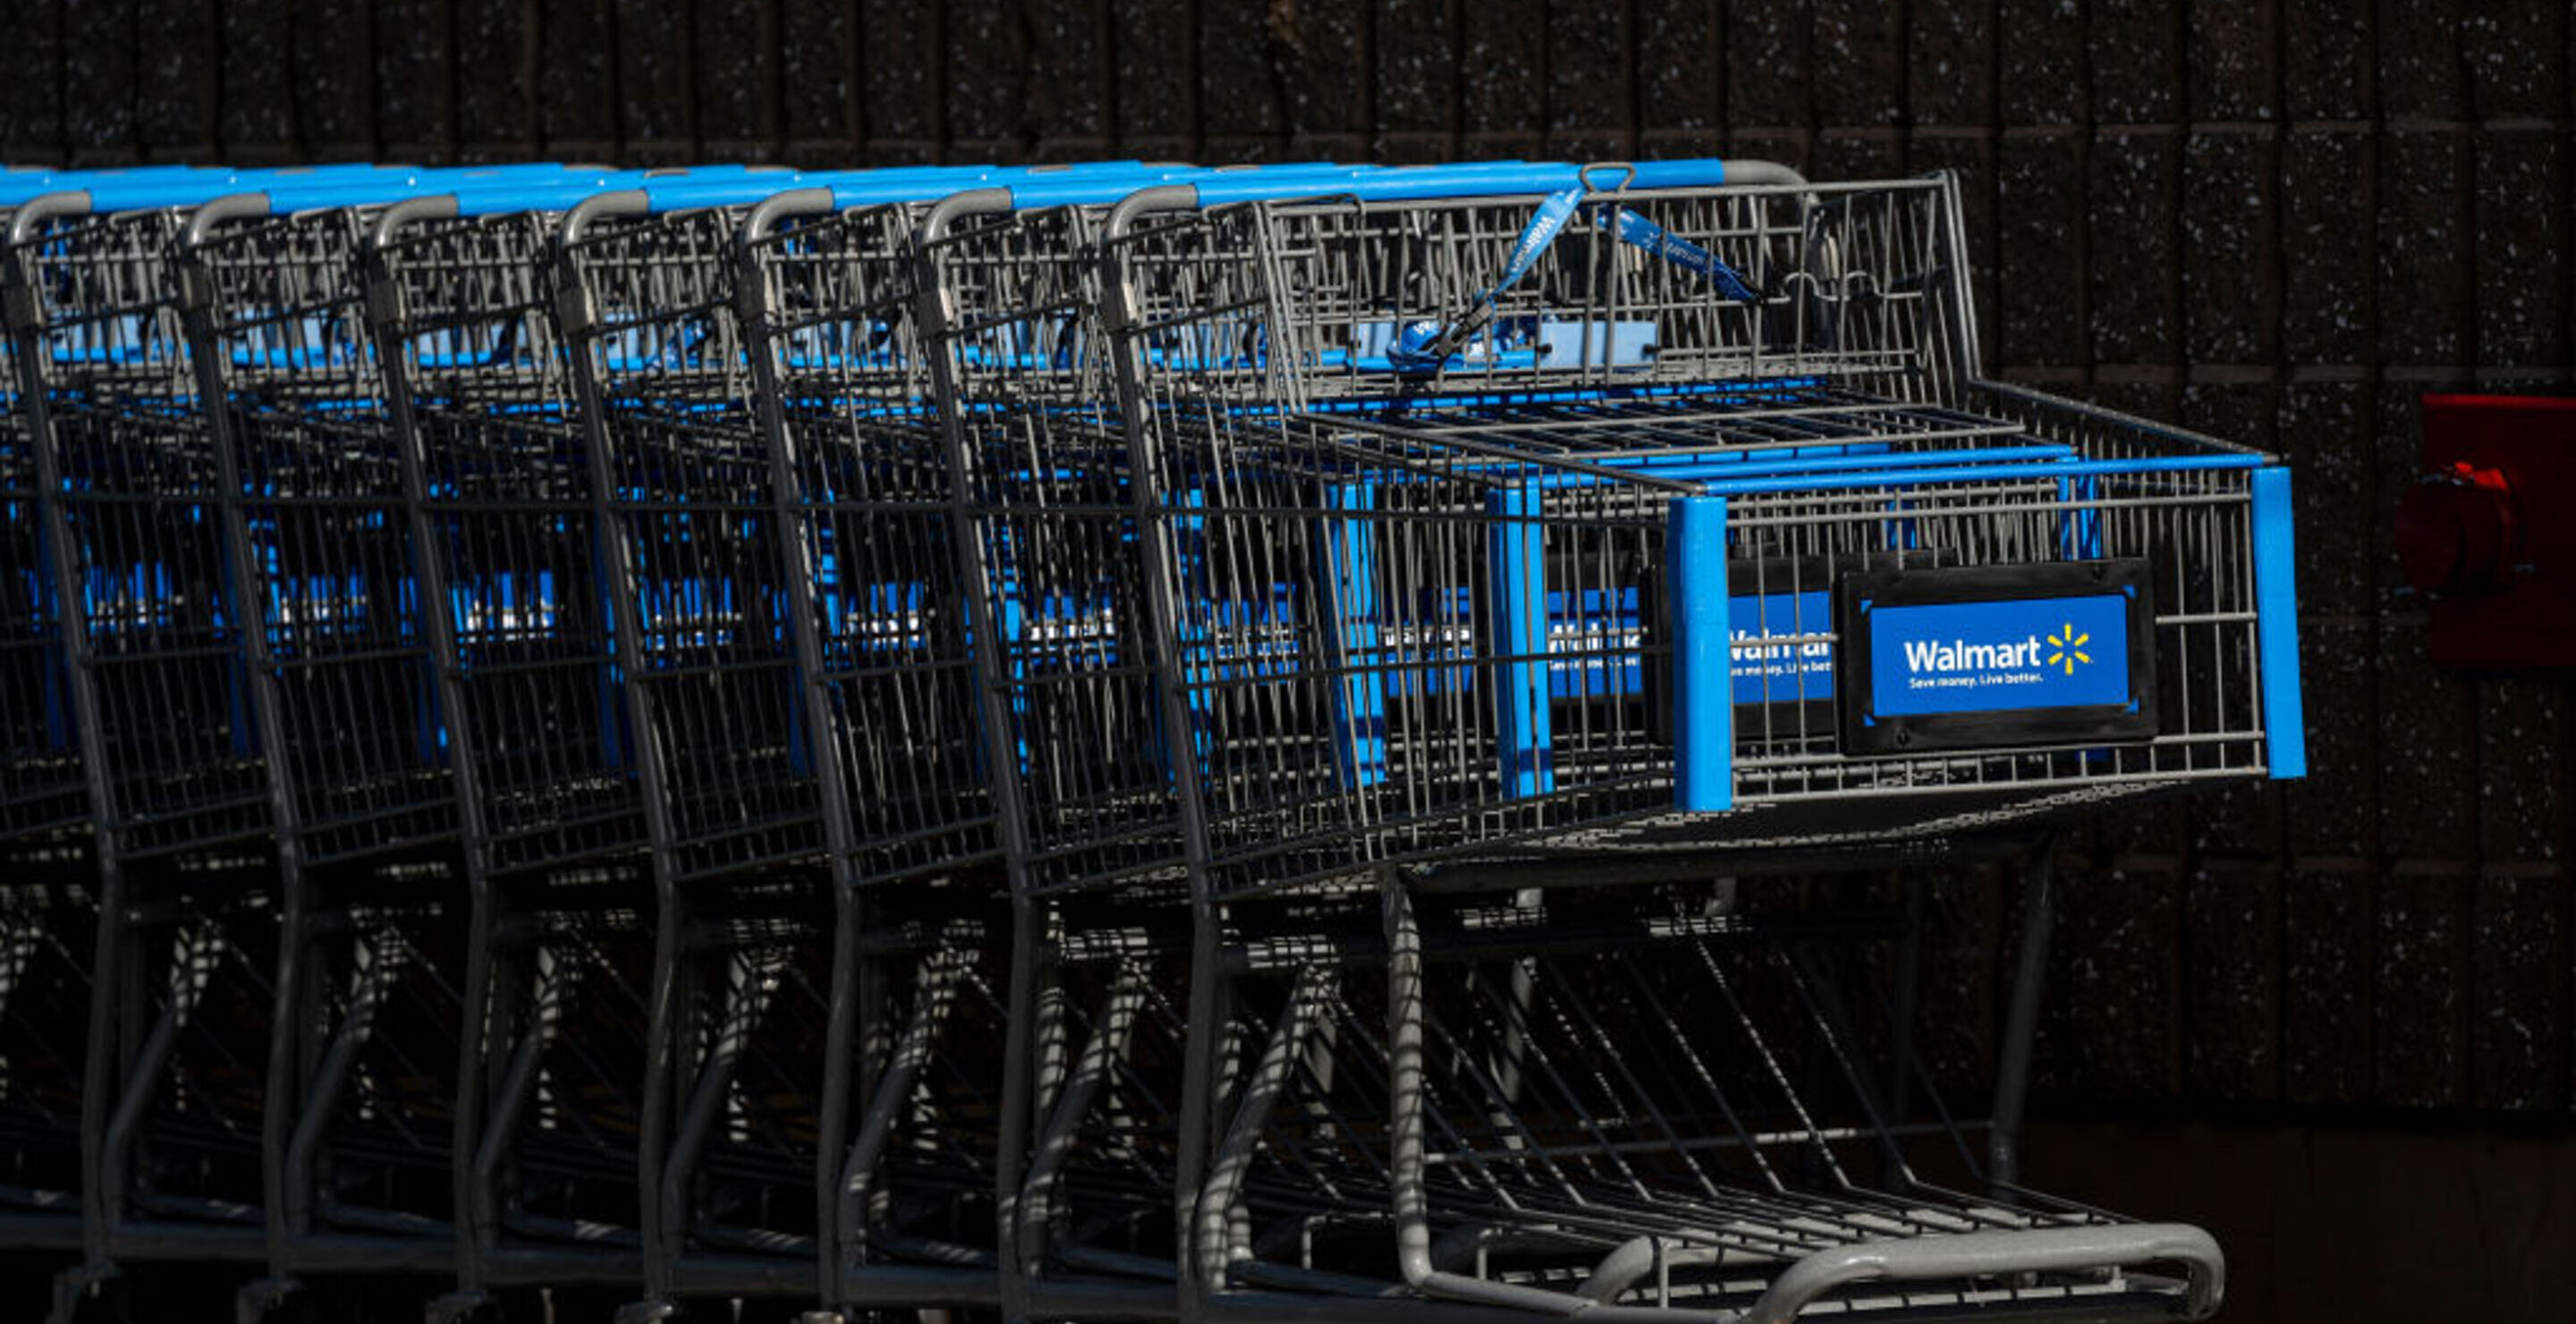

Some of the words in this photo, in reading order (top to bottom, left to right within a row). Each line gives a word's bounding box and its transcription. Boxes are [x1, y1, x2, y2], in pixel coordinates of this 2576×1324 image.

[1903, 634, 2041, 672] Walmart
[1909, 677, 1935, 689] Save
[1936, 676, 1978, 690] money.
[1979, 673, 2003, 685] Live
[2004, 672, 2044, 684] better.
